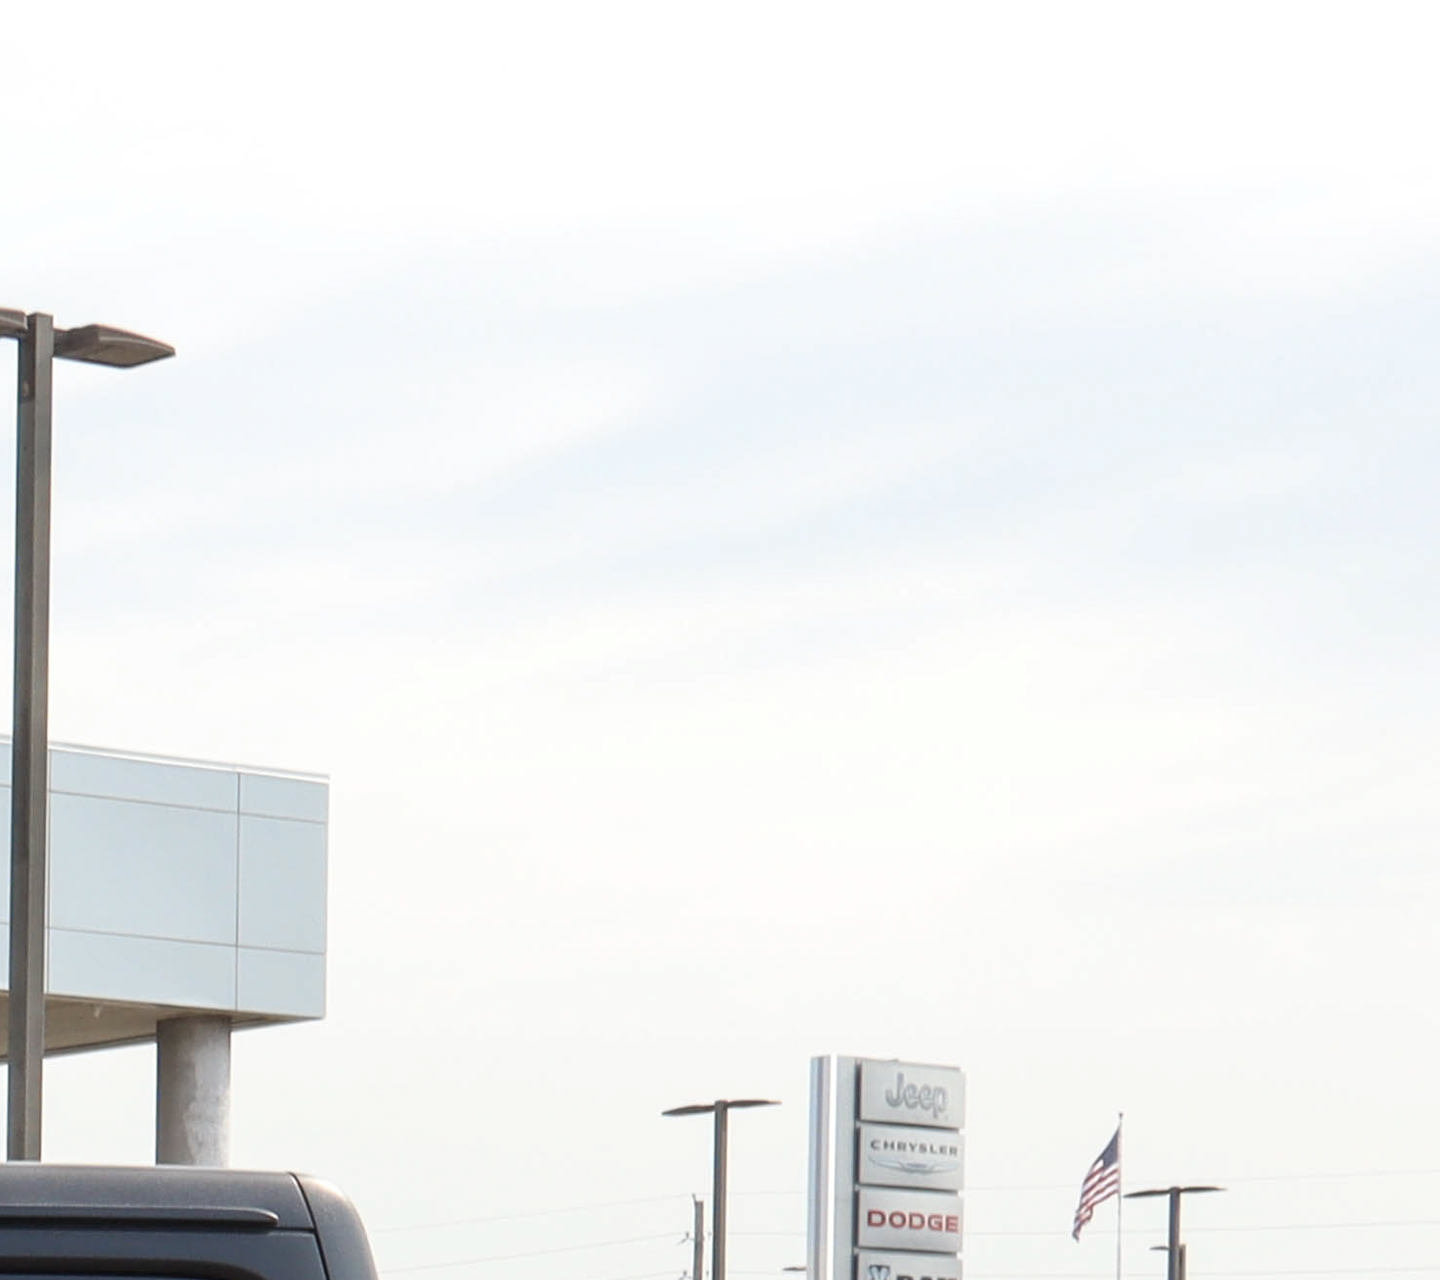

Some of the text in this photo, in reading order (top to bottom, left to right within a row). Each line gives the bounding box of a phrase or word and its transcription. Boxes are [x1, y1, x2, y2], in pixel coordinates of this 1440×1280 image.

[884, 1072, 949, 1120] Jeep
[870, 1139, 959, 1157] CHRYSLER
[867, 1209, 960, 1234] DODGE
